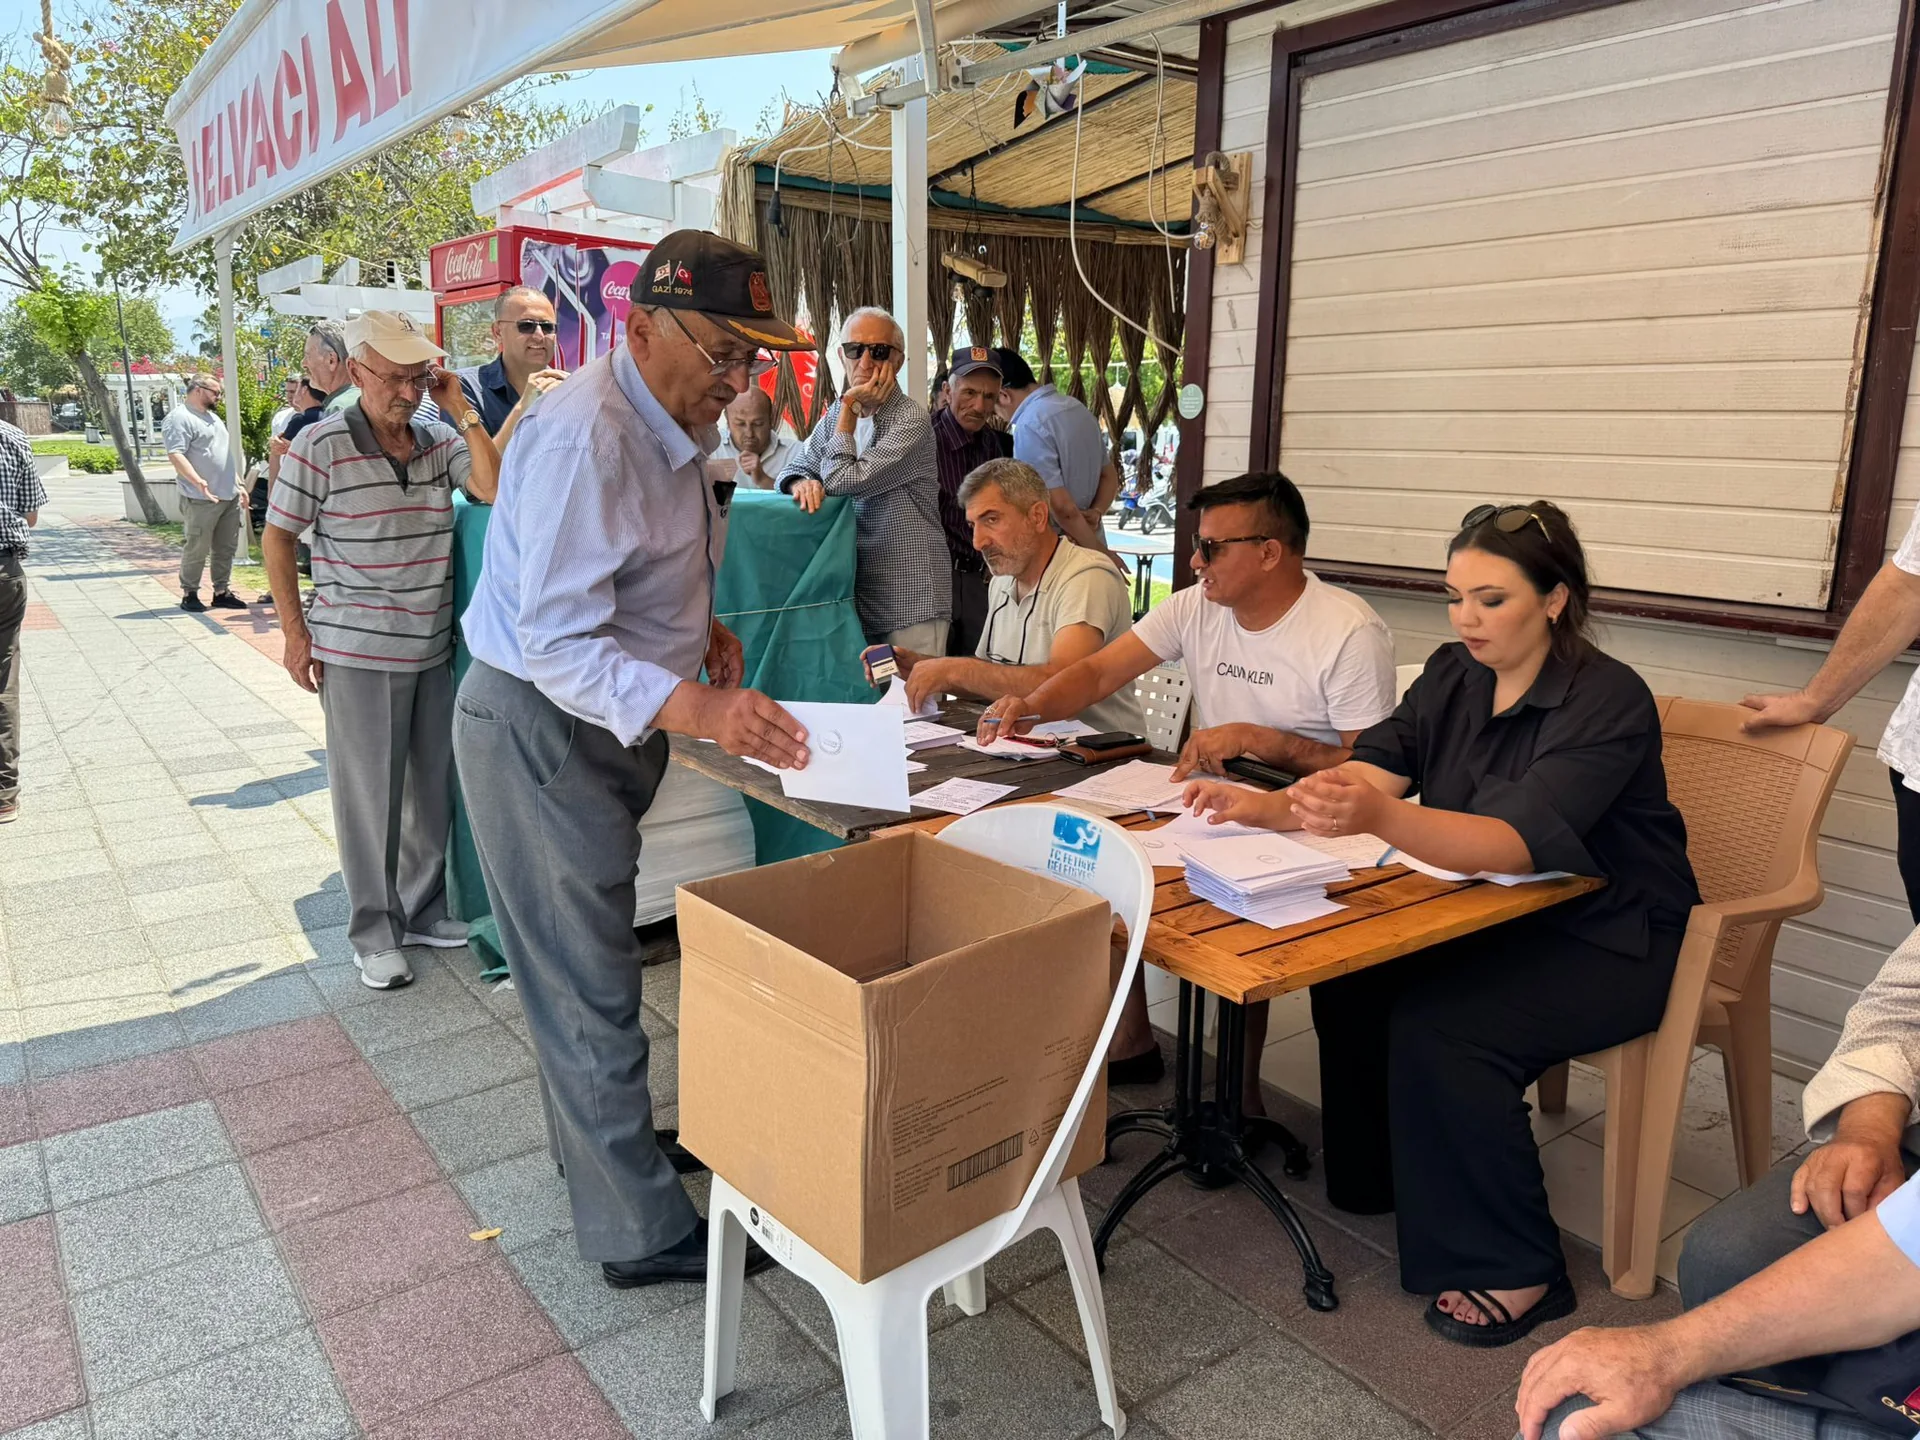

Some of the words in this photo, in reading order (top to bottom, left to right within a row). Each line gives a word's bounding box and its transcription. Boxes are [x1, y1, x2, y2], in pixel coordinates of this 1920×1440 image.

[444, 240, 486, 284] Coca-Cola
[673, 286, 694, 296] 1974
[1247, 670, 1274, 686] KLEIN
